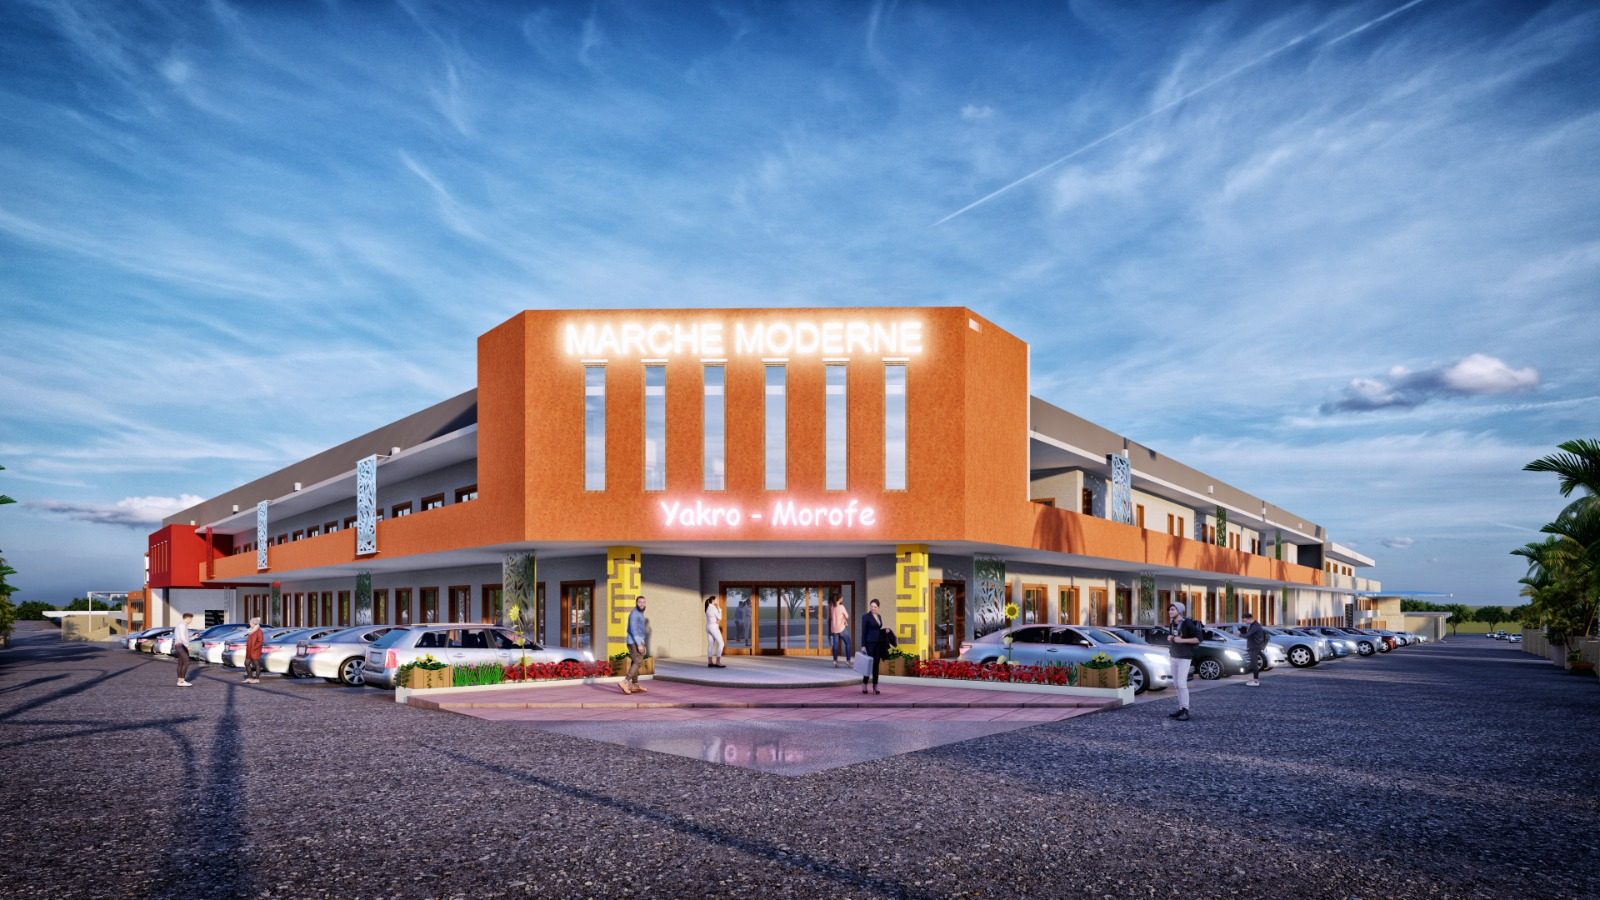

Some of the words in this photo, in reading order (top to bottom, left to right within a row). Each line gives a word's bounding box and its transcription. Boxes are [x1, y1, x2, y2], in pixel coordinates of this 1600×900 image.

[565, 322, 725, 354] MARCHE
[735, 321, 923, 353] MODERNE
[660, 500, 741, 527] Yakro
[771, 500, 876, 527] Morofe
